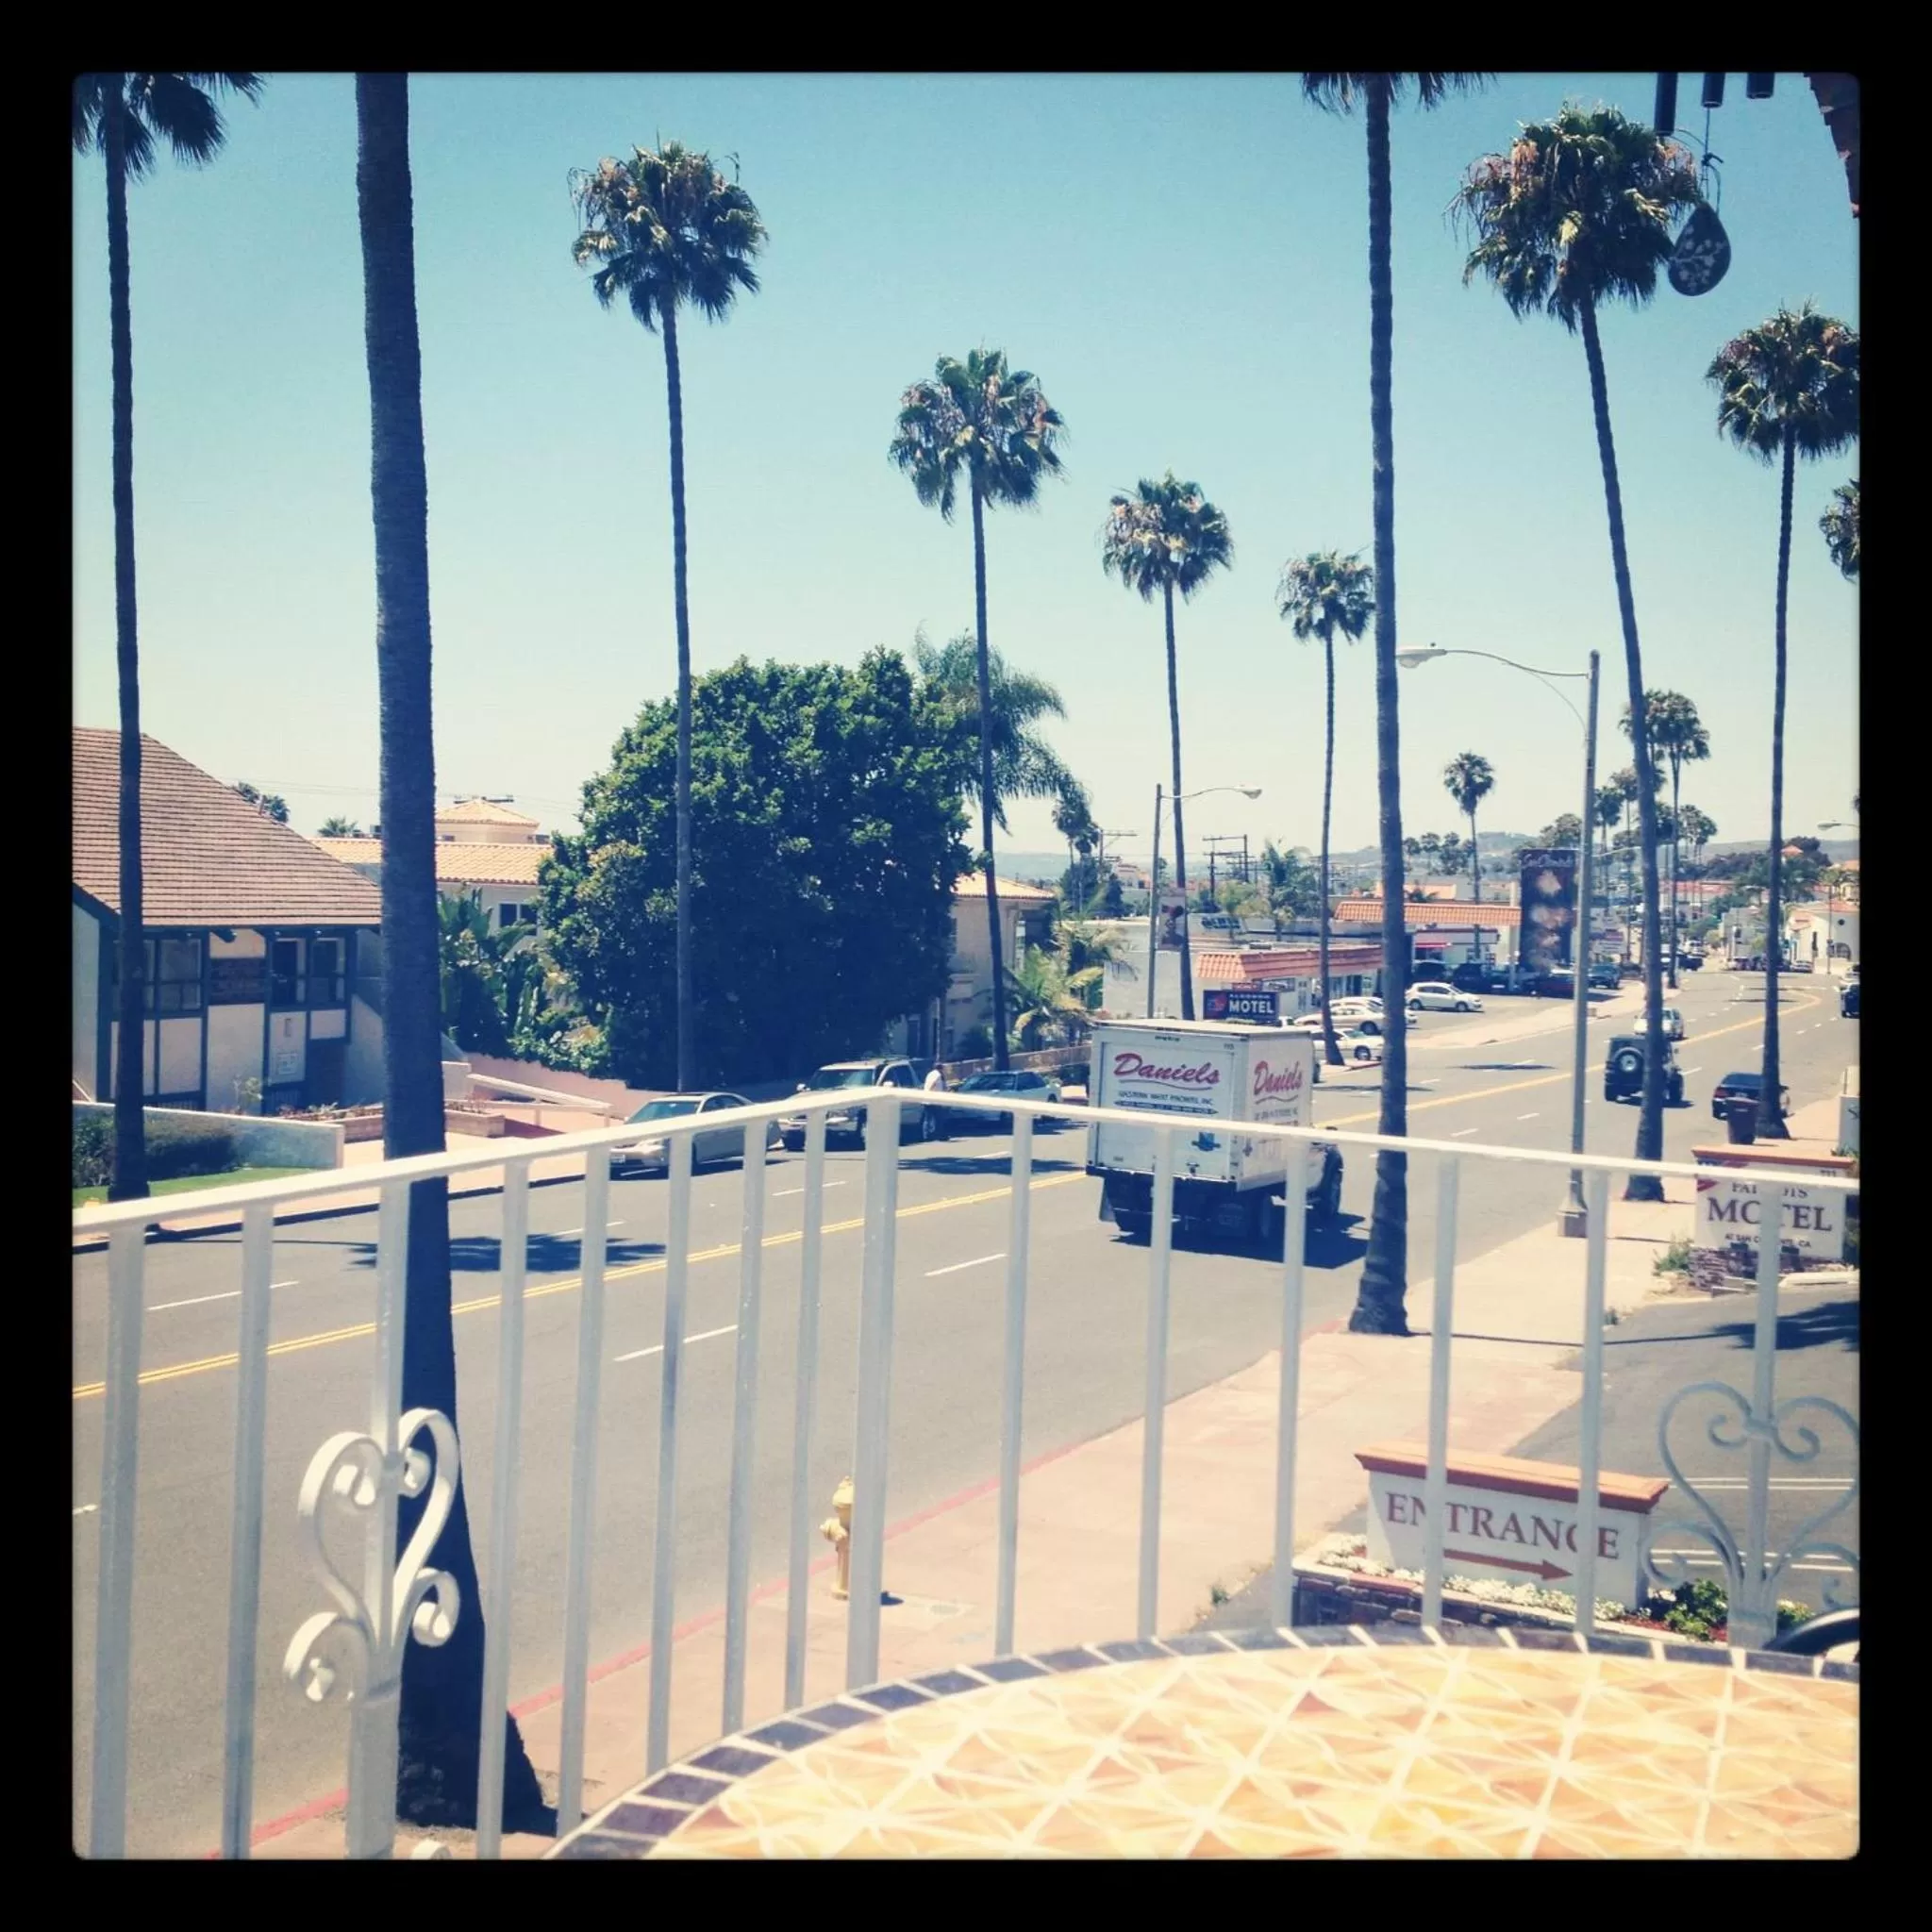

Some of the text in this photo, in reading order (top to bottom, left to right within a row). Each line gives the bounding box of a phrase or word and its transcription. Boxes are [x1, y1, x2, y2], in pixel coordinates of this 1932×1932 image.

[1228, 1000, 1274, 1014] MOTEL
[1113, 1053, 1221, 1084] Daniels
[1254, 1060, 1302, 1095] Daniels
[1707, 1197, 1832, 1232] MOEL
